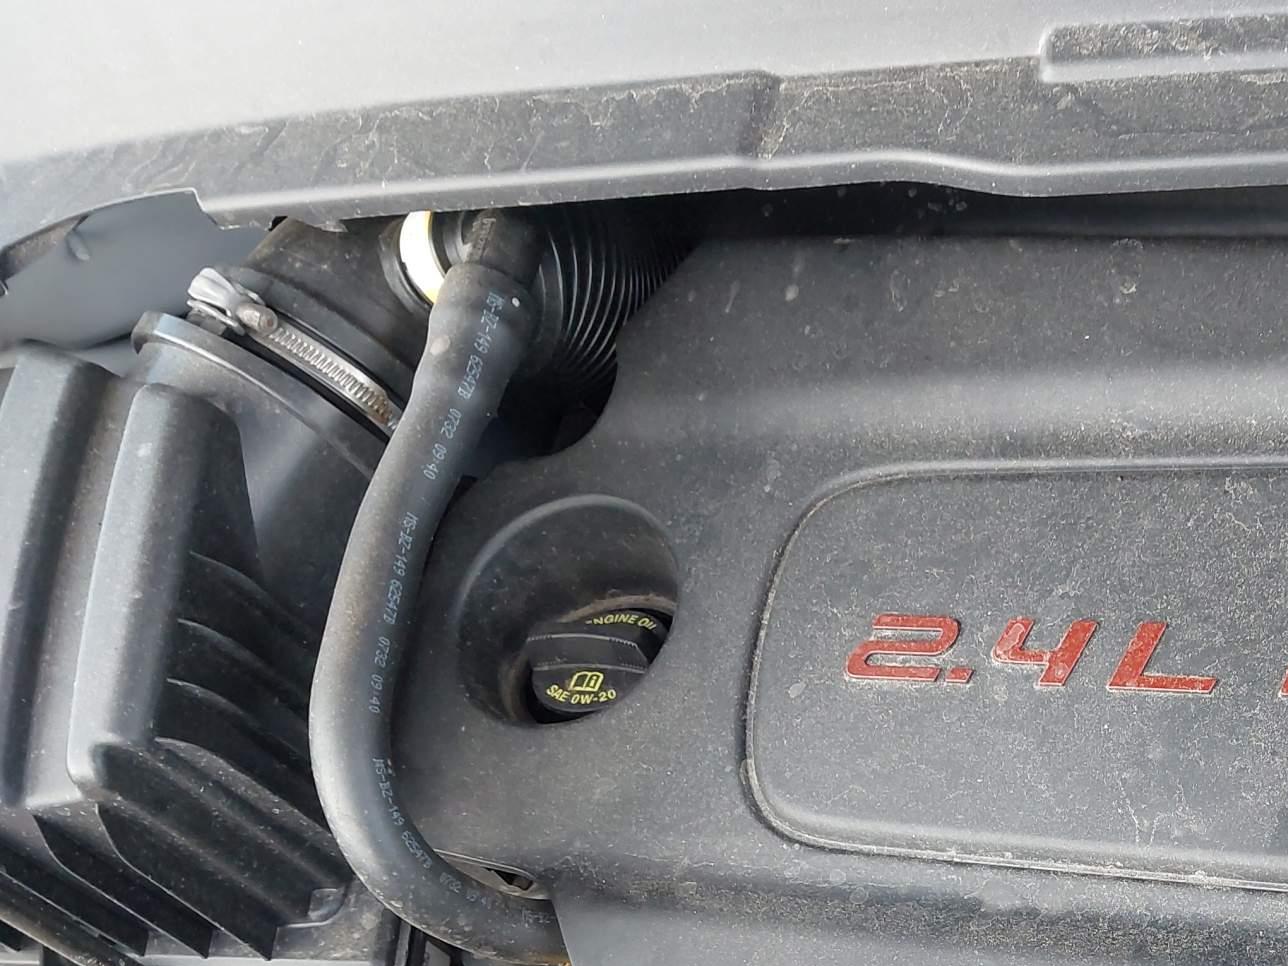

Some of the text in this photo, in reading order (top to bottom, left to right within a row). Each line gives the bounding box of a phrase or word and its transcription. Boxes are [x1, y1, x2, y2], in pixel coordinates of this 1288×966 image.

[439, 408, 463, 440] 0732
[373, 636, 391, 668] 0732
[546, 684, 617, 704] SAE 0W-20
